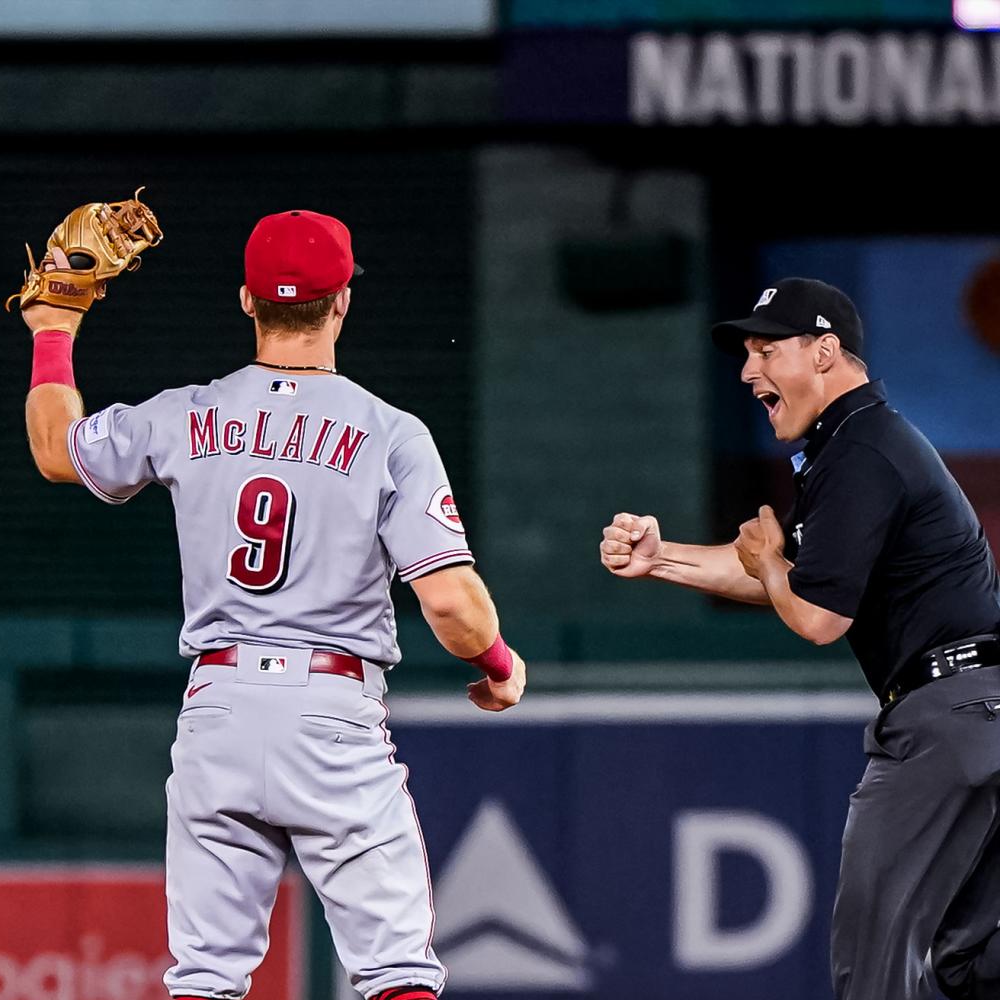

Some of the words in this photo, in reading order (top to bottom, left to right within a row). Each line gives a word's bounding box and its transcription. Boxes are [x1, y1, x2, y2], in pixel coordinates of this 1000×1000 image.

[630, 33, 1000, 125] NATIONA
[187, 406, 369, 476] McLAIN
[226, 473, 297, 595] 9
